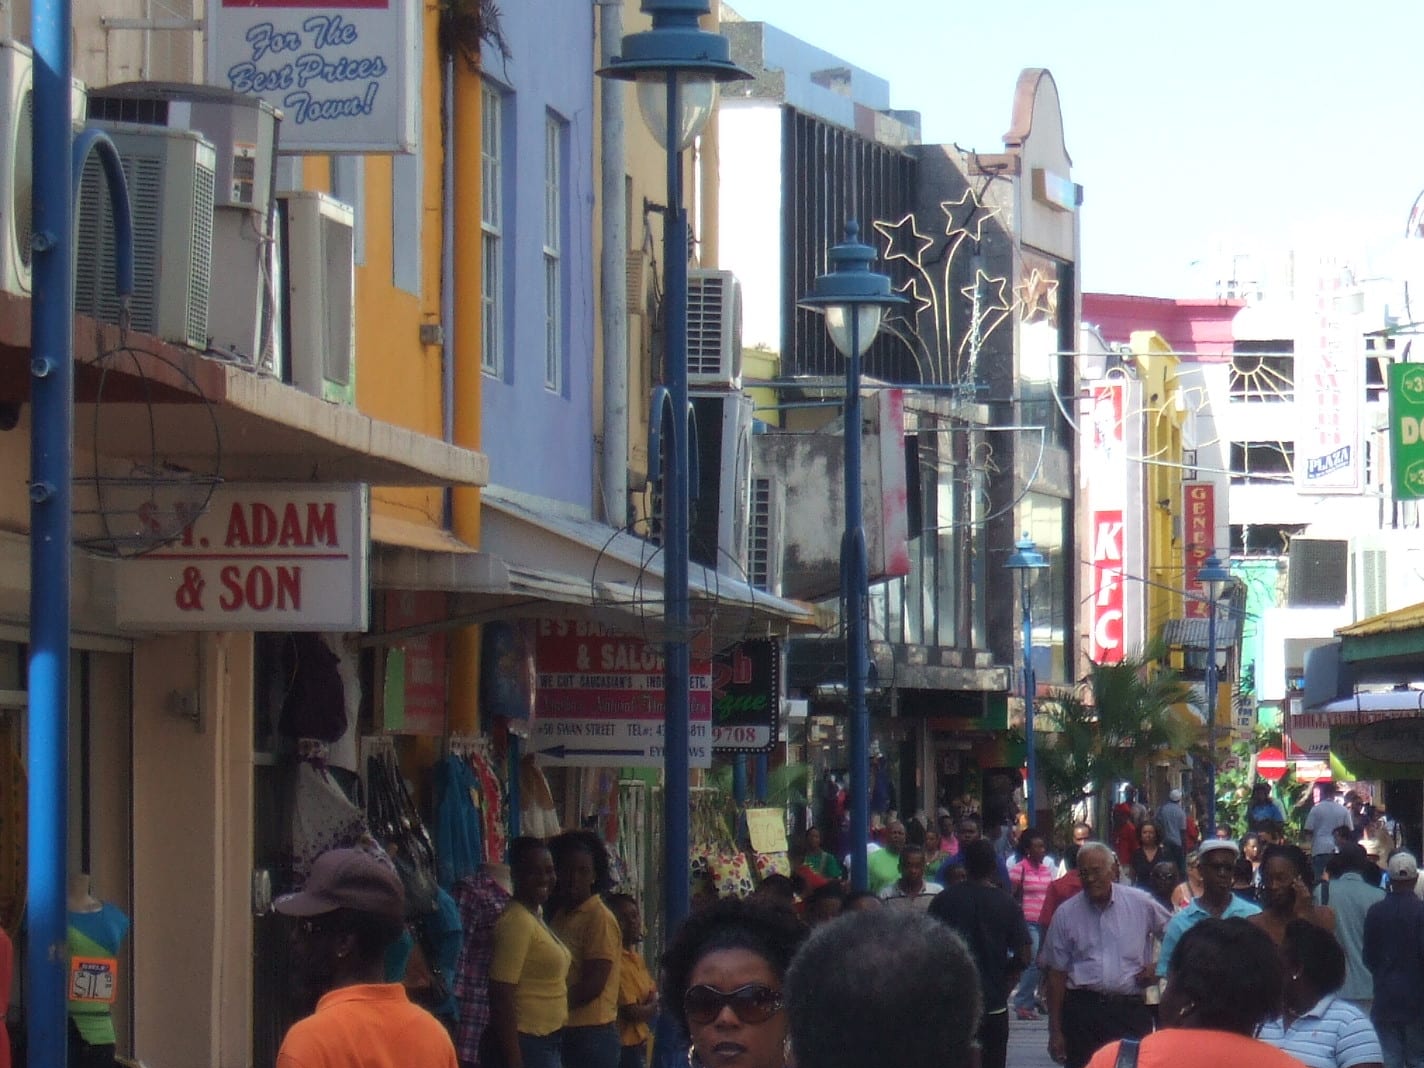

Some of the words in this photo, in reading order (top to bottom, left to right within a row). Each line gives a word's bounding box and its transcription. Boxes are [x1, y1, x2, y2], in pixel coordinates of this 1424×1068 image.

[246, 23, 301, 61] For
[303, 15, 357, 49] The
[228, 61, 294, 93] Best
[295, 53, 388, 88] Prices
[283, 82, 379, 125] Town!
[1309, 448, 1349, 472] PLAZA
[224, 502, 340, 547] ADAM
[175, 565, 206, 612] &
[218, 564, 303, 612] SON
[1095, 521, 1122, 650] KFC
[576, 644, 591, 670] &
[585, 722, 616, 736] STREET
